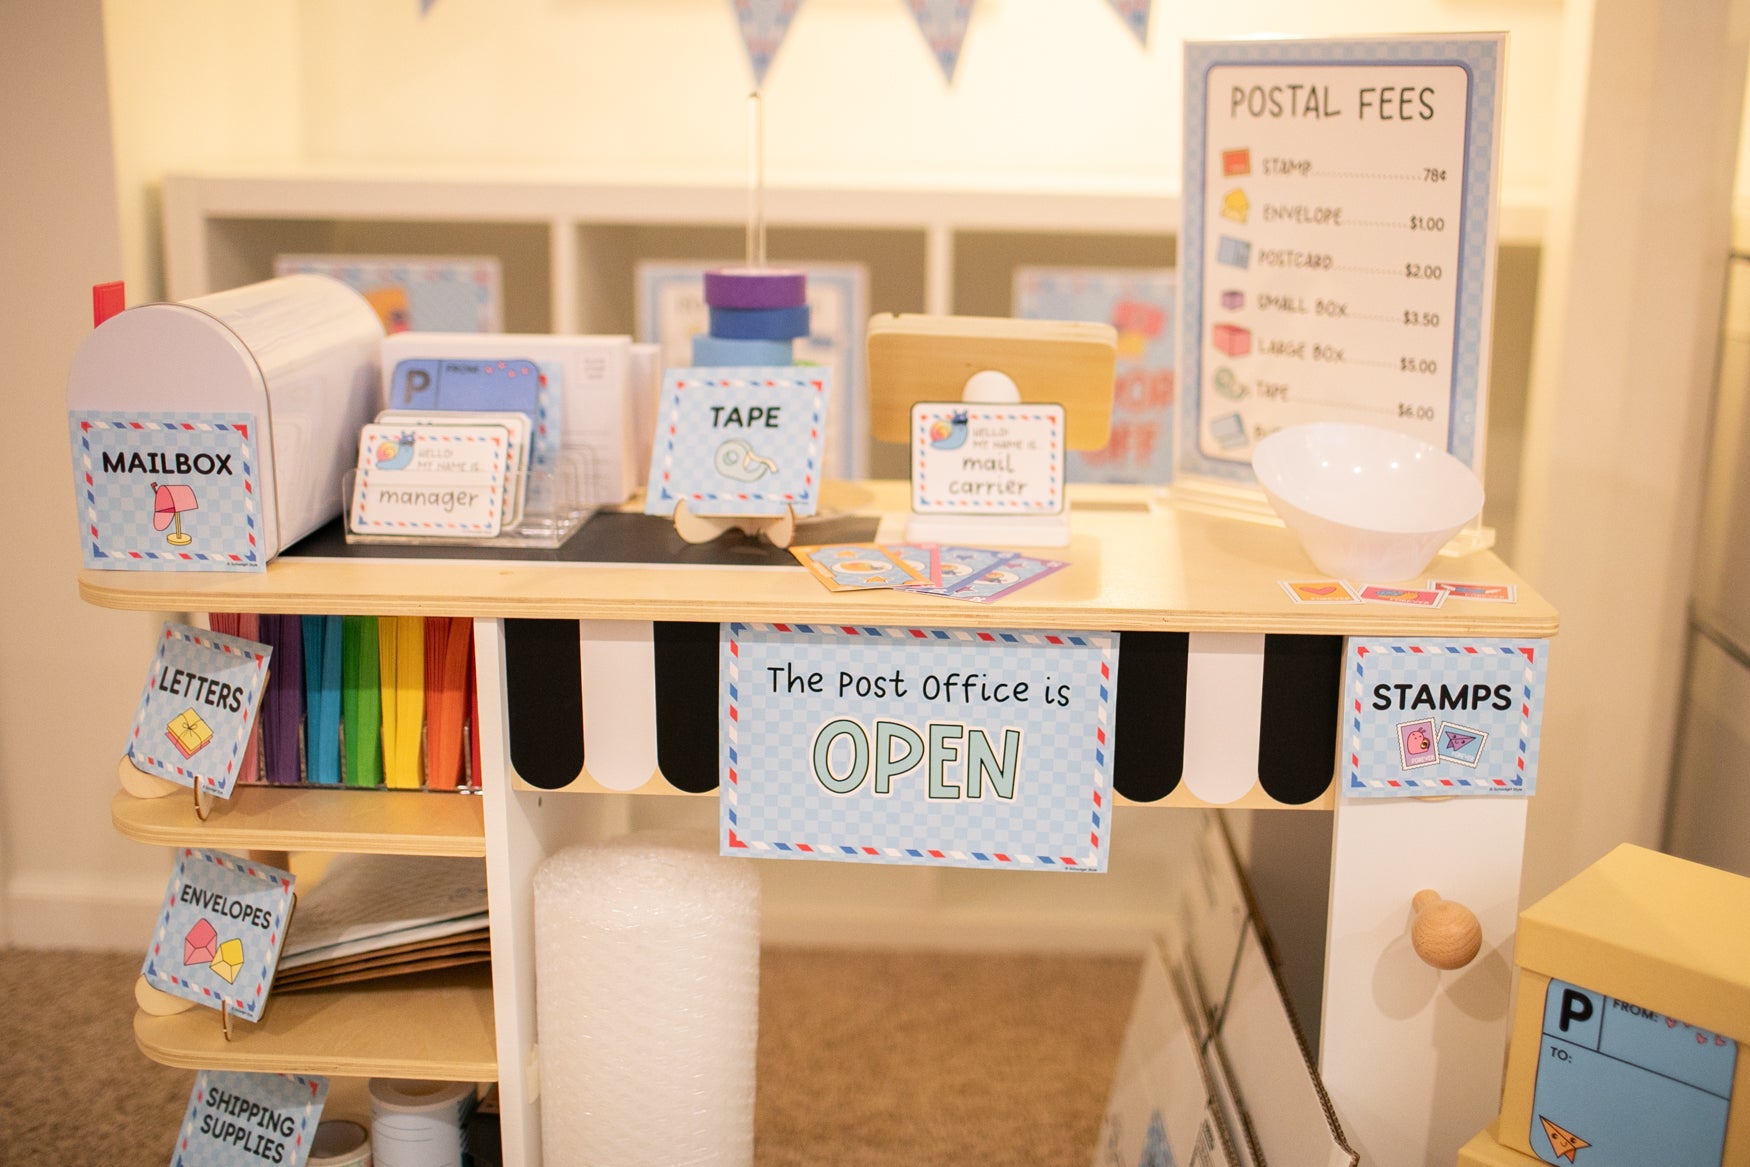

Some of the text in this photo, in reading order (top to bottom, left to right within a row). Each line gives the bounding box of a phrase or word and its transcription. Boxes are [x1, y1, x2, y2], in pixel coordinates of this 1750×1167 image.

[1230, 85, 1435, 121] POSTAL FEES
[1262, 158, 1447, 183] STAMP 78¢
[1263, 204, 1445, 233] ENVELOPE $1.00
[1258, 249, 1442, 280] POSTCARD $2.00
[1256, 294, 1440, 328] SMALL BOX $3.50
[1257, 338, 1437, 375] LARGE BOX $5.00
[404, 370, 431, 403] P
[710, 406, 781, 428] TAPE
[102, 451, 233, 476] MAILBOX
[962, 453, 1015, 473] mail
[379, 489, 480, 513] manager
[948, 480, 1027, 496] carrier
[158, 666, 244, 713] LETTERS
[767, 662, 1070, 707] The Post Office is
[1372, 683, 1512, 711] STAMPS
[811, 717, 1022, 801] OPEN
[180, 884, 272, 930] ENVELOPES
[1559, 988, 1594, 1032] P
[1550, 1046, 1573, 1063] TO:
[205, 1086, 295, 1137] SHIPPING
[200, 1113, 285, 1164] SUPPLIES
